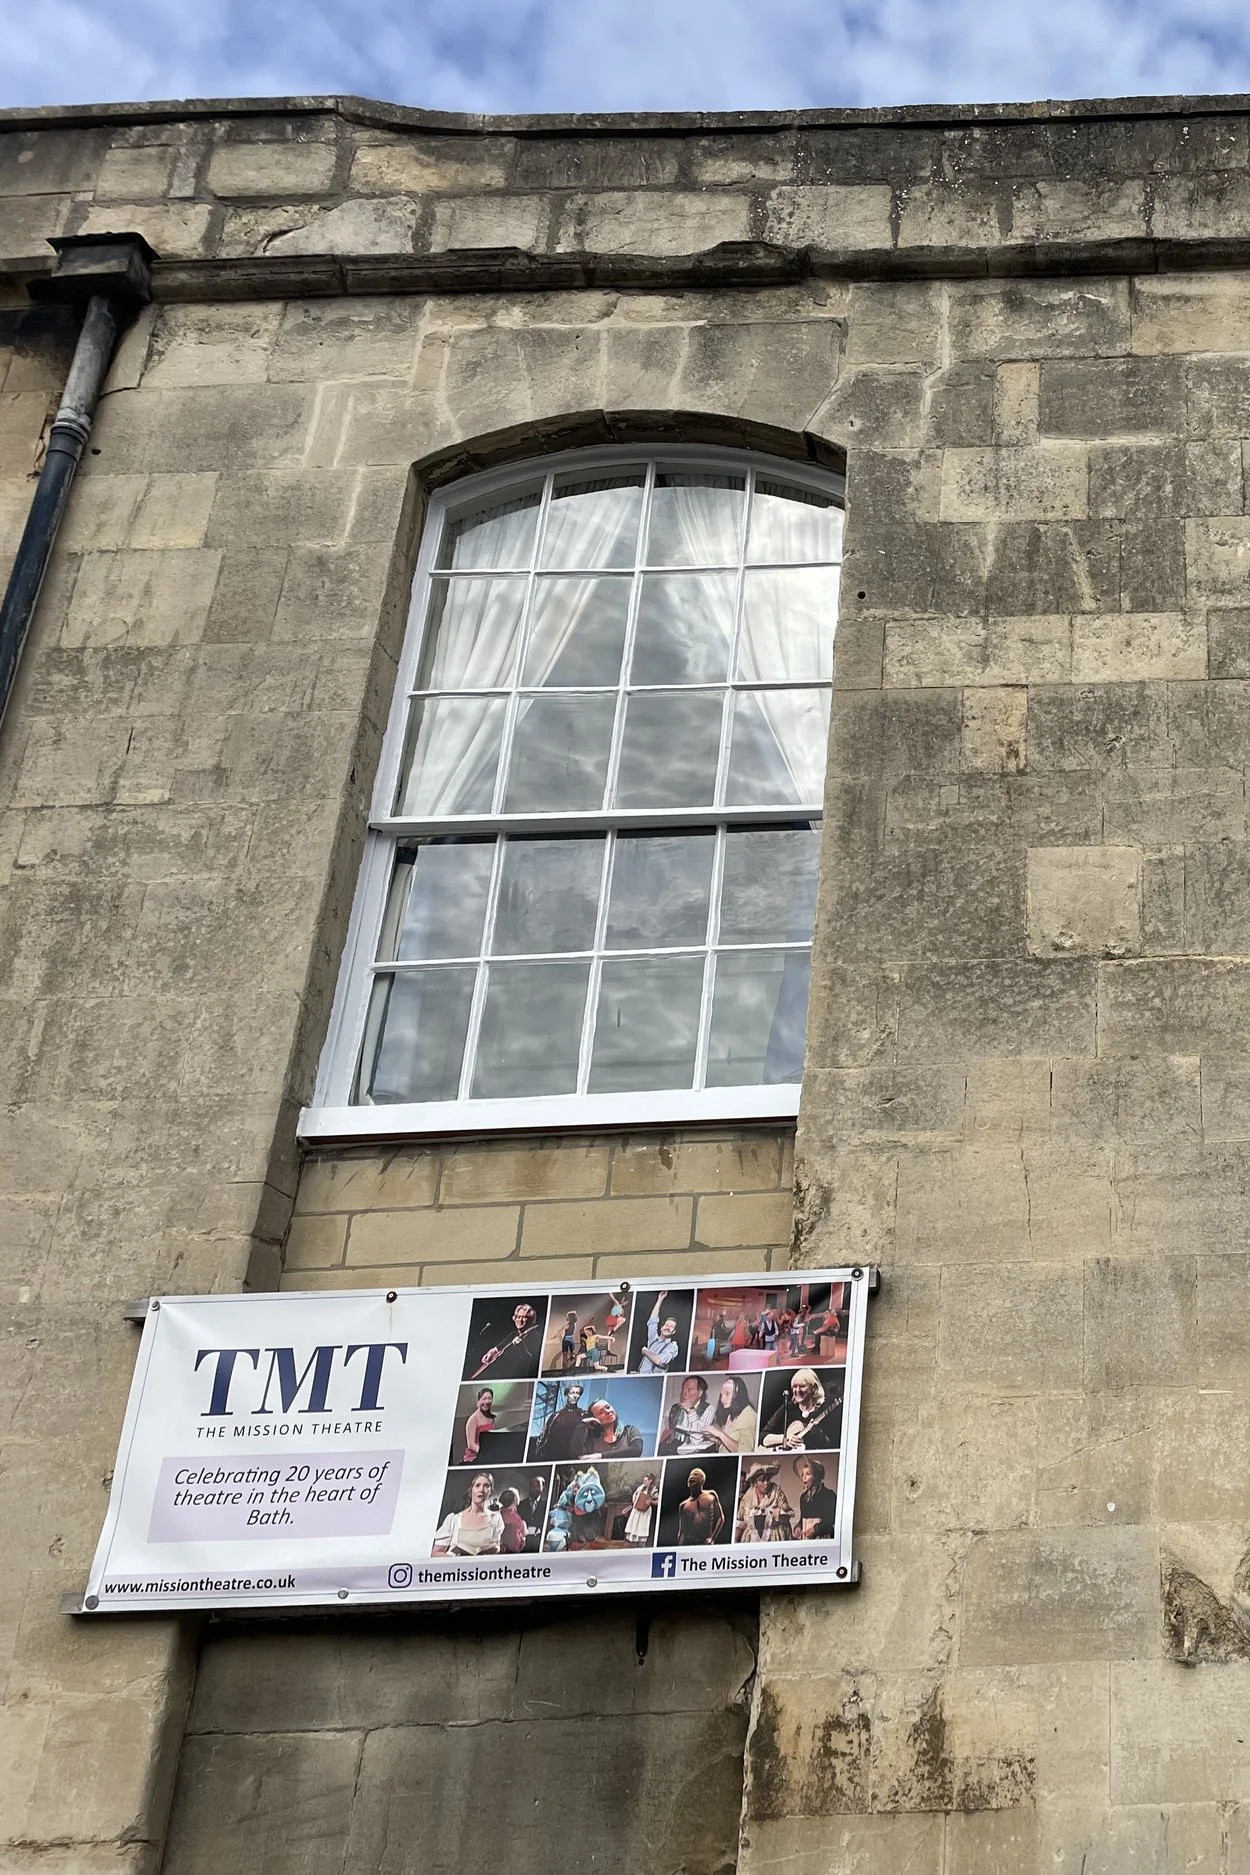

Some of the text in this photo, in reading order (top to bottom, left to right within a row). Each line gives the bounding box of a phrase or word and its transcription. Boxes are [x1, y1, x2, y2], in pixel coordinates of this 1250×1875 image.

[194, 1342, 408, 1416] TMT
[196, 1421, 383, 1438] THE MISSION THEATRE
[174, 1461, 390, 1486] Celebrating 20 years of
[174, 1483, 382, 1505] theatre in the heart of
[246, 1508, 294, 1525] Bath.
[681, 1558, 707, 1572] The
[711, 1555, 767, 1570] Mission
[772, 1553, 828, 1568] Theatre
[418, 1566, 551, 1583] themissiontheatre
[105, 1575, 296, 1593] www.missiontheatre.co.uk
